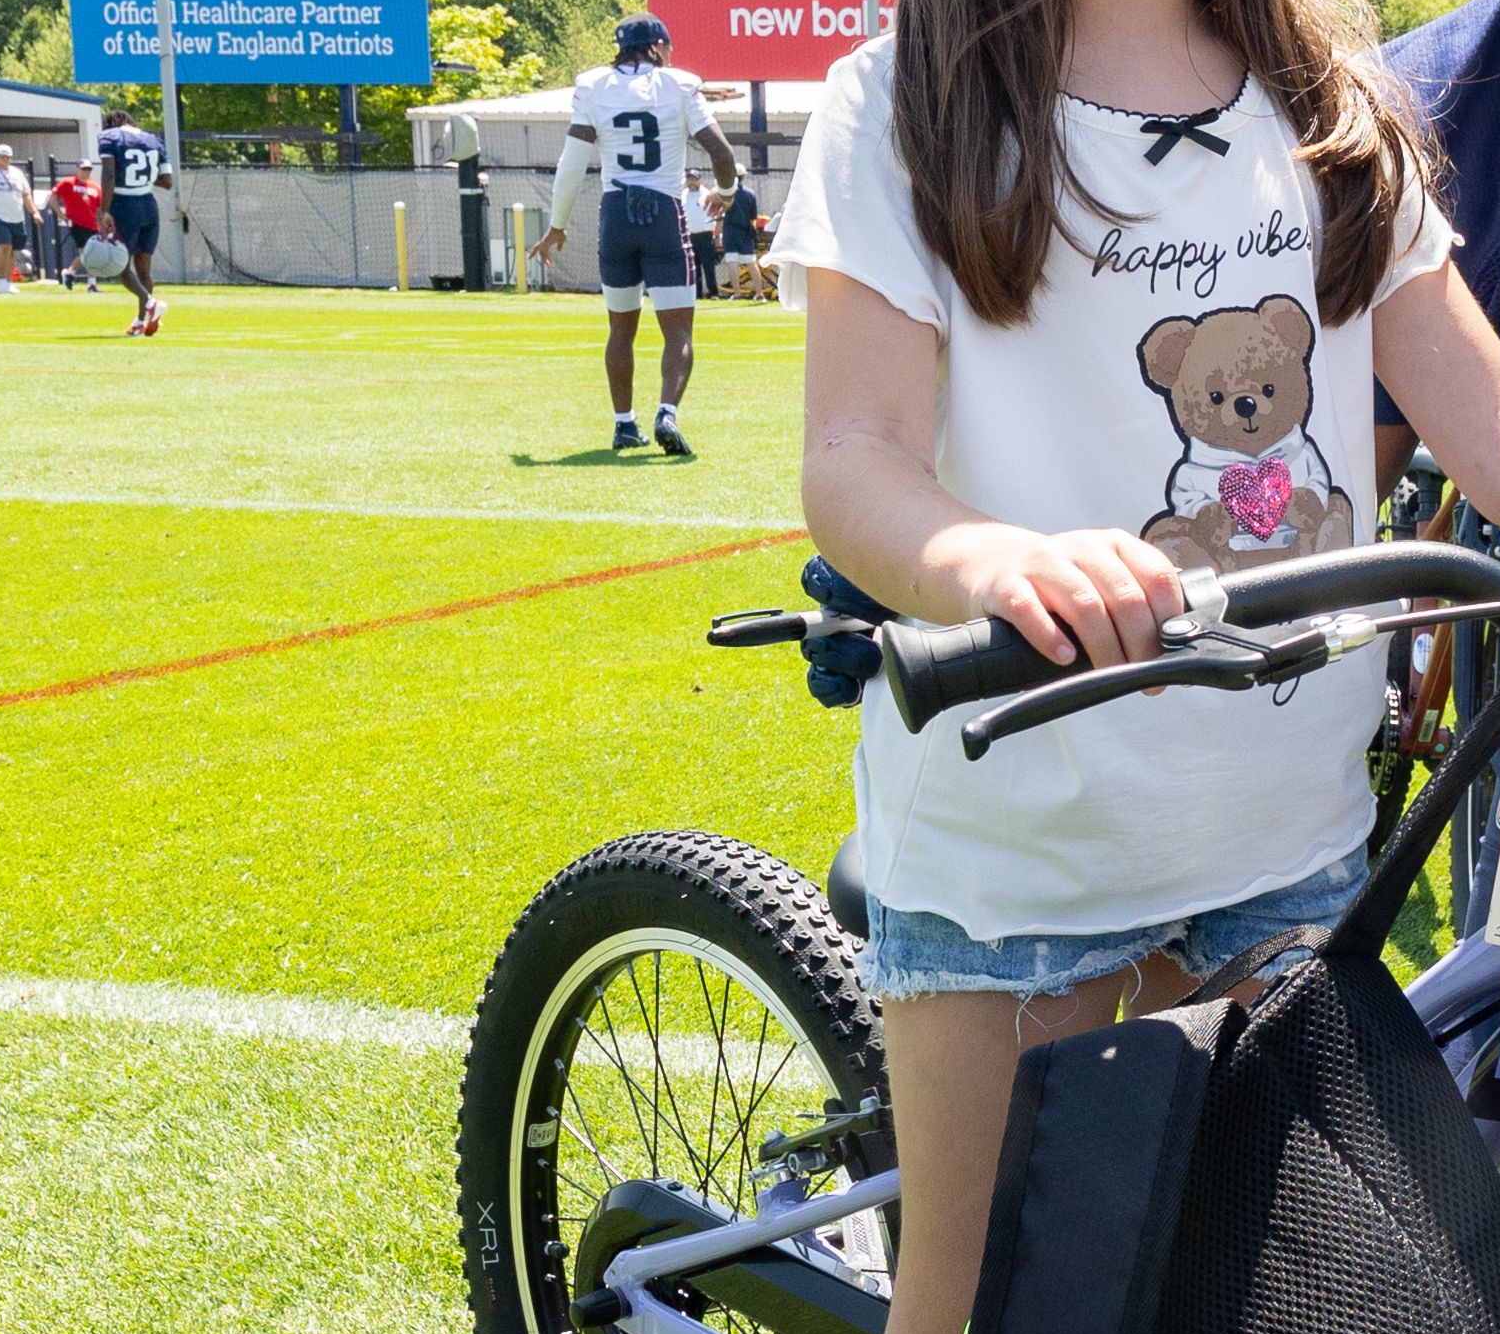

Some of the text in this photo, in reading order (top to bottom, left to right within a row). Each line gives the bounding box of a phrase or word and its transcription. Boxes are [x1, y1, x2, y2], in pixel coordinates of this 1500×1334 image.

[103, 0, 382, 26] Officil Healthcare Partner
[730, 0, 895, 37] new bala
[103, 30, 394, 60] of the New England Patriots
[612, 111, 662, 172] 3
[124, 149, 159, 186] 21
[1091, 209, 1312, 298] happy vibe
[476, 1201, 499, 1271] XR1
